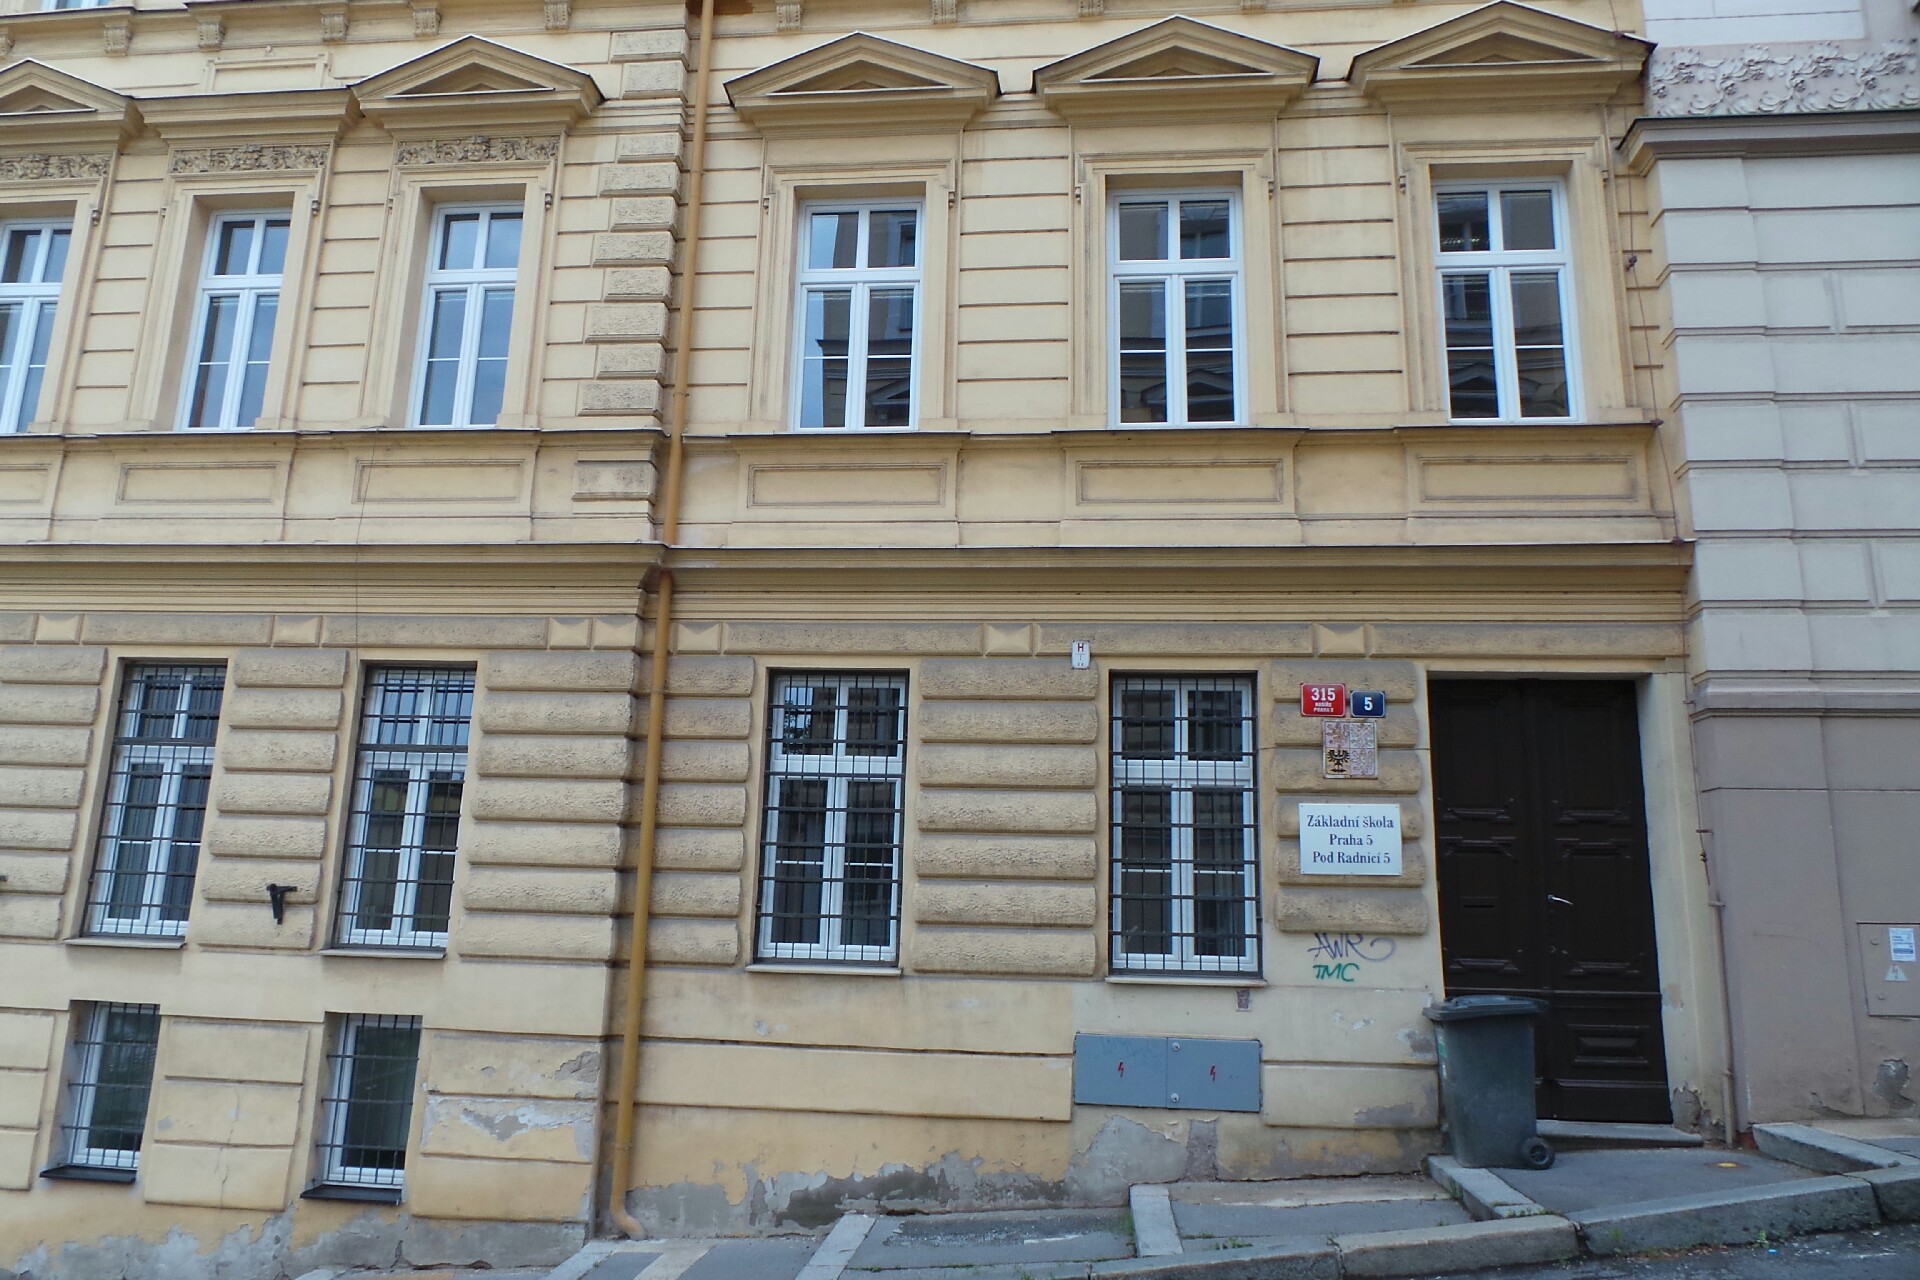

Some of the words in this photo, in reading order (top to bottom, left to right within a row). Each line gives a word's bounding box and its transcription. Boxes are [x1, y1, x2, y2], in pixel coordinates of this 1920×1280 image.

[1077, 642, 1084, 653] H
[1311, 687, 1336, 702] 315
[1364, 696, 1373, 711] 5
[1307, 814, 1360, 828] Základní
[1362, 815, 1394, 828] škola
[1329, 833, 1363, 846] Praha
[1366, 834, 1373, 846] 5
[1313, 850, 1334, 863] Pod
[1337, 851, 1380, 864] Radnicí
[1383, 852, 1391, 864] 5
[1312, 962, 1360, 982] TMC
